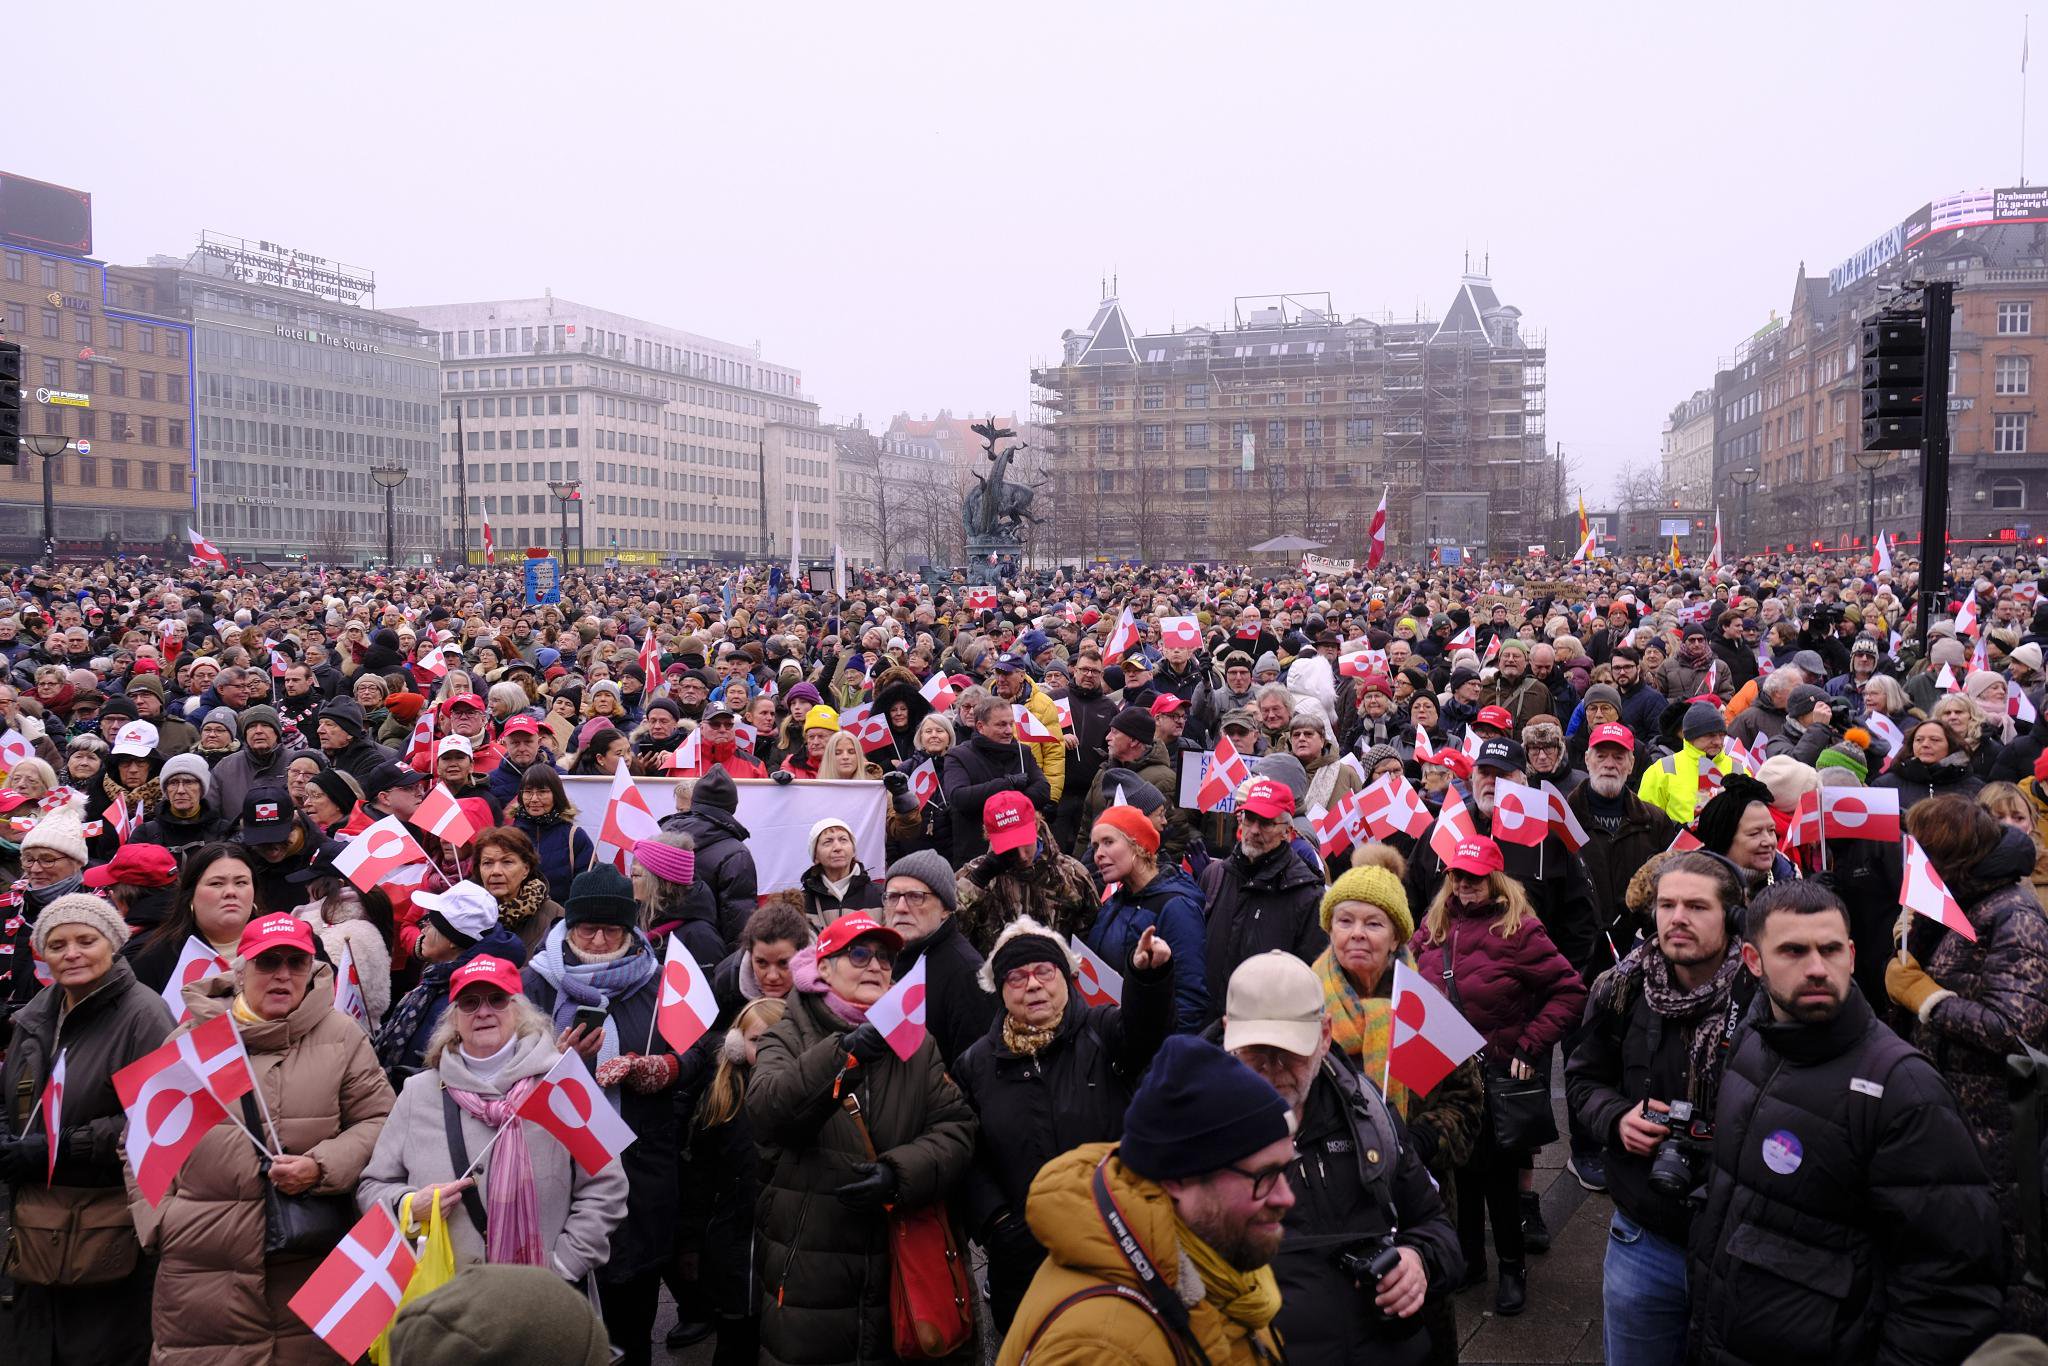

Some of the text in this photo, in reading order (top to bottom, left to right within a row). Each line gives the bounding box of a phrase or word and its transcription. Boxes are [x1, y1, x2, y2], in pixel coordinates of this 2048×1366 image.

[1997, 191, 2047, 201] Drabsmand
[1996, 200, 2009, 208] fik
[2001, 208, 2028, 217] døden
[269, 243, 326, 265] The Square
[1828, 221, 1905, 298] POLITIKEN
[258, 271, 289, 286] BEDSTE
[276, 324, 379, 354] Hotel The Square
[1486, 748, 1508, 757] NUUK!
[1498, 743, 1509, 751] det
[995, 808, 1018, 821] Nu det
[997, 815, 1020, 828] NUUK!
[278, 918, 294, 926] det
[262, 926, 295, 935] NUUK!
[464, 965, 496, 975] NUUK!
[1725, 1000, 1739, 1039] SONY
[1129, 1250, 1155, 1281] EOS
